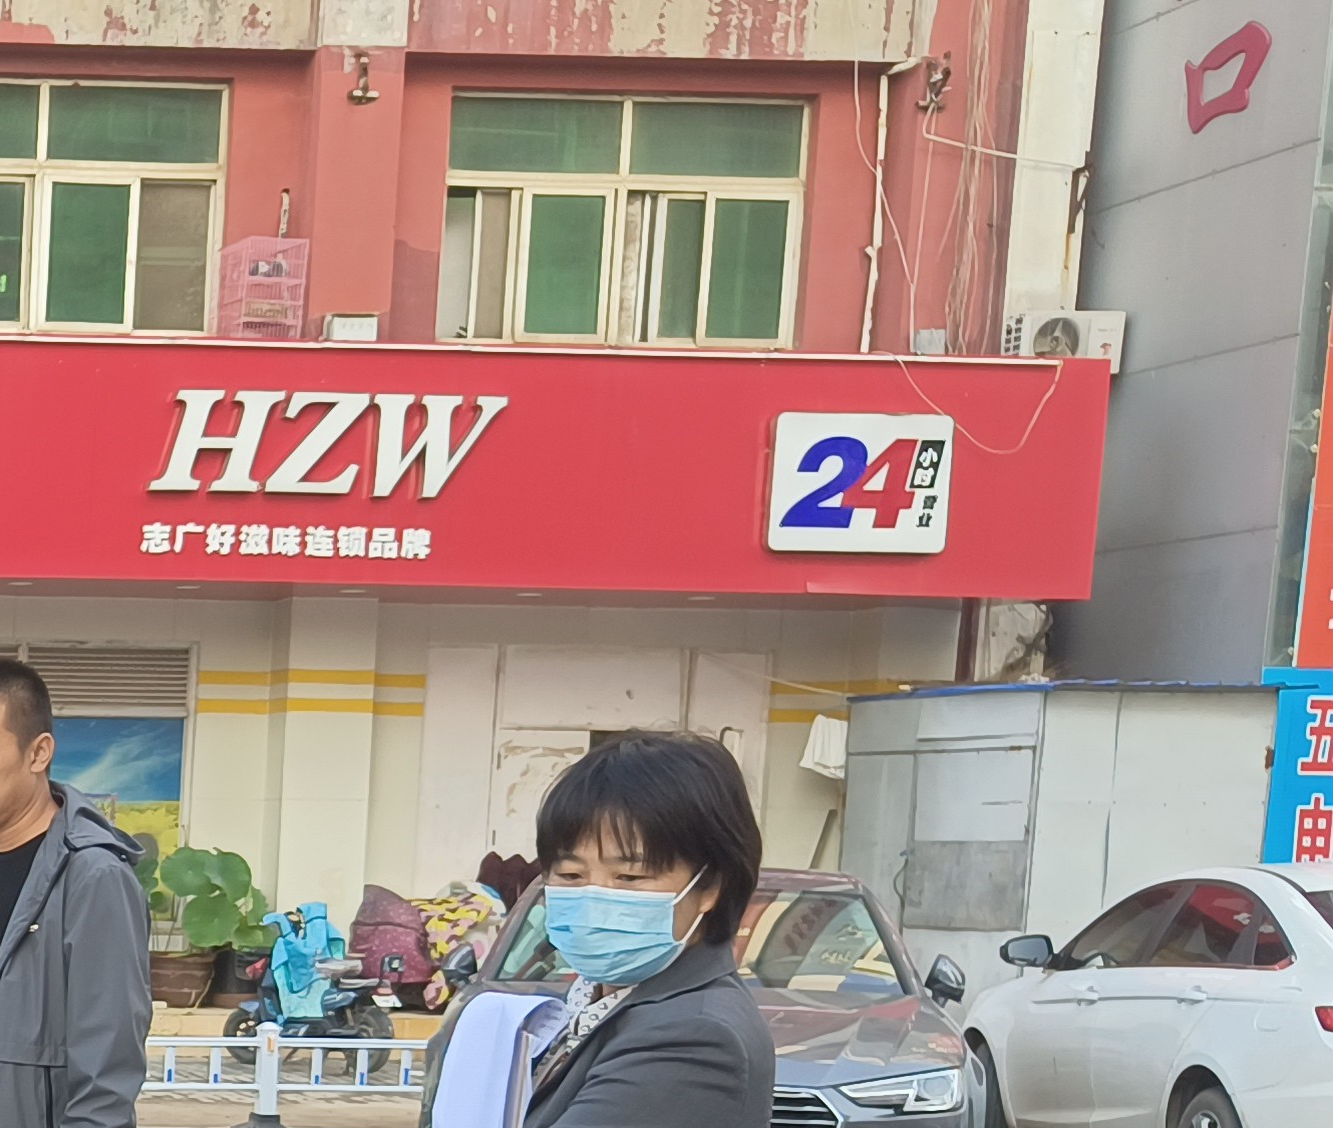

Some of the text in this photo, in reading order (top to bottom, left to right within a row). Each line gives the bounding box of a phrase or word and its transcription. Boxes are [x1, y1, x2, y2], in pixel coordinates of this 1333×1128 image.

[147, 389, 509, 499] HZW
[779, 436, 918, 529] 24
[140, 522, 432, 559] 志广好滋味连锁品牌
